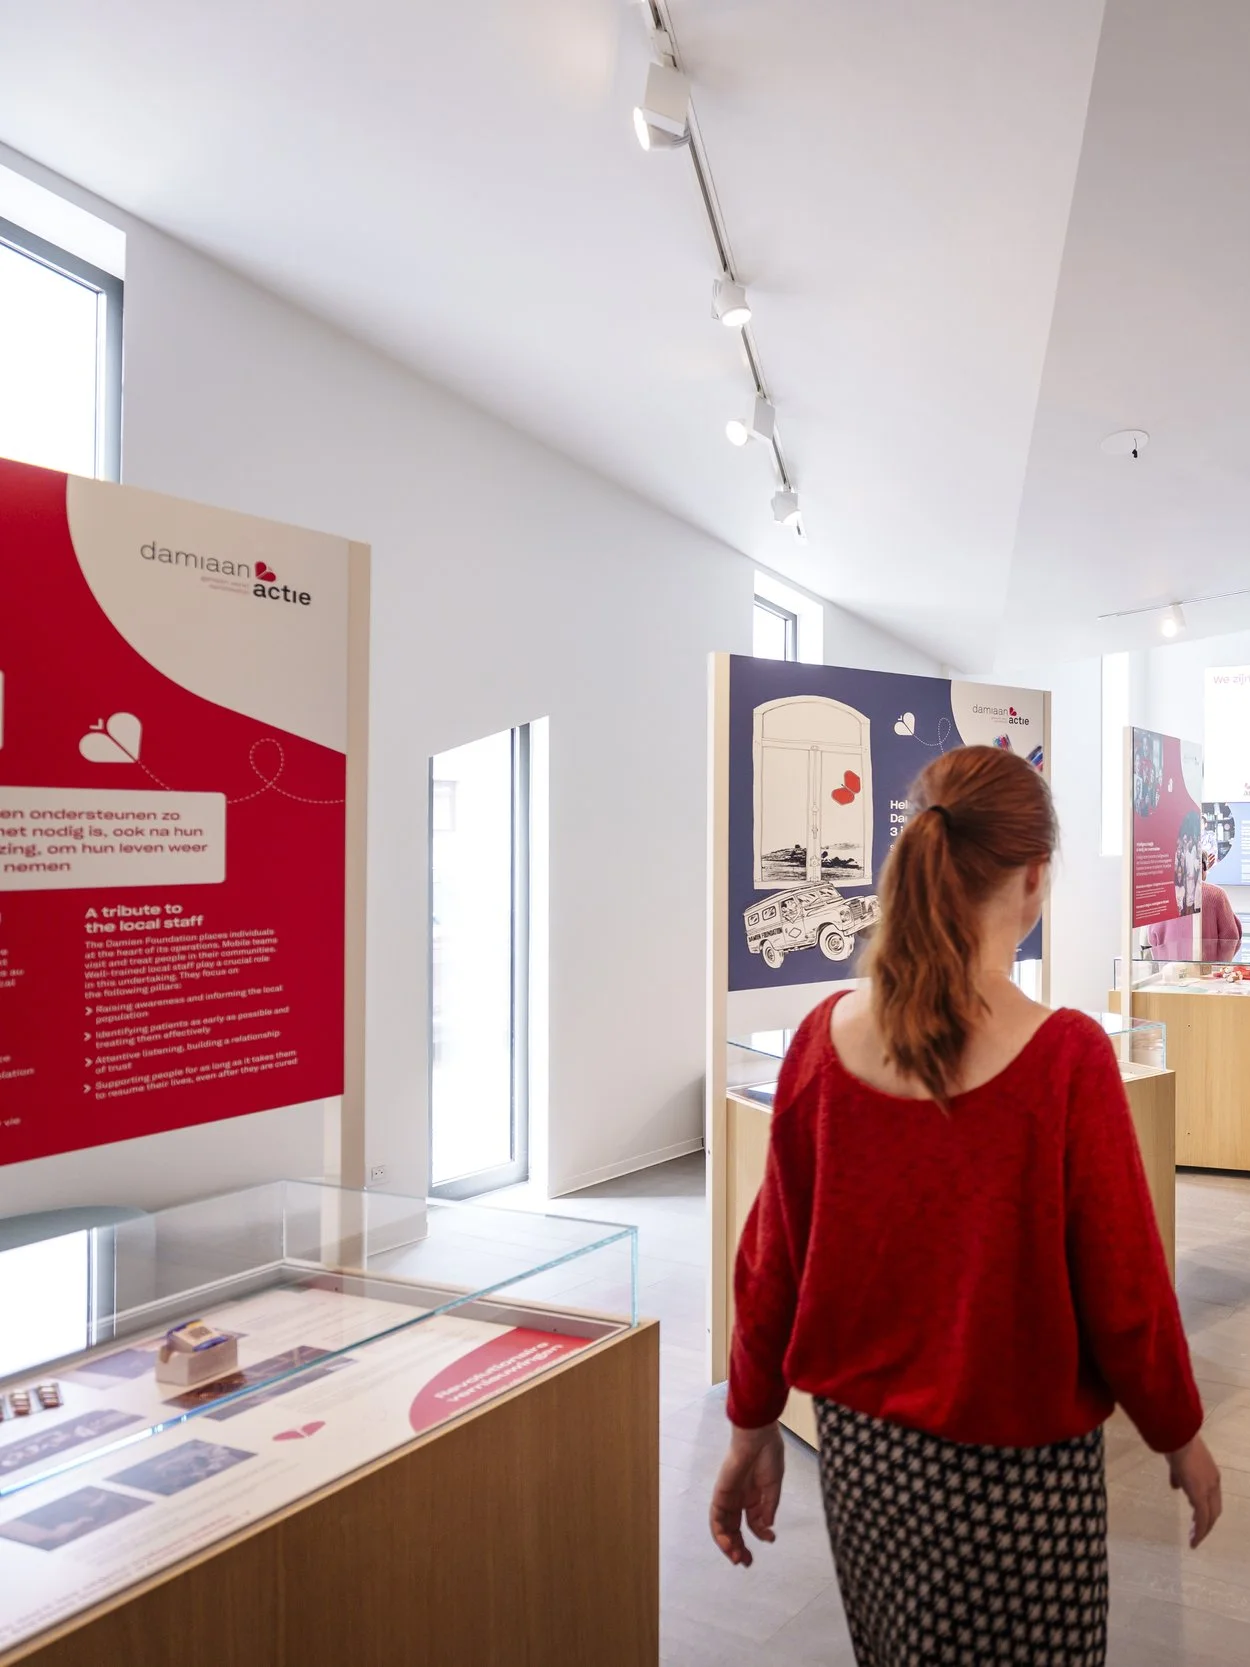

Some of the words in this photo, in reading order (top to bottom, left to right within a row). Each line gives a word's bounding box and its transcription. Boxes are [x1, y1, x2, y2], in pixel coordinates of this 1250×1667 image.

[140, 541, 250, 578] damiaan
[253, 583, 312, 605] actie
[1213, 675, 1230, 684] We
[972, 704, 1009, 716] damiaan
[1008, 716, 1030, 726] actie
[30, 809, 157, 821] ondersteunen
[162, 812, 181, 821] zo
[32, 825, 84, 840] nodig
[88, 825, 108, 838] is,
[112, 826, 145, 837] ook
[150, 828, 170, 837] na
[174, 826, 204, 837] hun
[47, 844, 76, 855] om
[81, 843, 115, 854] hun
[119, 843, 164, 853] leven
[168, 844, 209, 853] weer
[3, 862, 71, 873] nemen
[85, 907, 98, 919] A
[101, 904, 162, 918] tribute
[164, 903, 183, 914] to
[84, 922, 116, 934] the
[119, 918, 161, 932] local
[163, 915, 204, 929] staff
[85, 941, 104, 949] The
[105, 939, 143, 948] Damien
[145, 935, 198, 945] Foundation
[199, 933, 228, 942] places
[229, 928, 275, 938] individuals
[85, 951, 96, 959] at
[97, 950, 115, 958] the
[116, 948, 142, 957] heart
[144, 946, 156, 954] of
[156, 945, 169, 953] its
[170, 942, 220, 953] operations.
[222, 939, 251, 948] Mobile
[252, 937, 278, 945] teams
[84, 960, 106, 969] visit
[108, 958, 128, 967] and
[129, 956, 152, 965] treat
[154, 954, 186, 964] people
[187, 952, 196, 960] in
[198, 951, 219, 959] their
[147, 964, 171, 973] local
[172, 961, 195, 971] staff
[195, 961, 215, 970] play
[223, 956, 252, 966] crucial
[253, 955, 270, 963] role
[84, 981, 95, 989] in
[96, 979, 116, 988] this
[179, 971, 200, 979] They
[202, 968, 226, 977] focus
[84, 990, 102, 999] the
[103, 985, 149, 998] following
[95, 1003, 133, 1013] Raising
[134, 997, 185, 1009] awareness
[186, 994, 204, 1003] and
[205, 990, 247, 1000] informing
[263, 984, 284, 993] local
[95, 1010, 149, 1025] population
[95, 1026, 149, 1039] Identifying
[150, 1020, 189, 1032] patients
[202, 1015, 224, 1024] early
[237, 1008, 272, 1021] possible
[273, 1006, 290, 1014] and
[95, 1038, 136, 1049] treating
[136, 1034, 162, 1043] them
[163, 1026, 211, 1039] effectively
[95, 1051, 141, 1064] Attentive
[186, 1039, 224, 1051] building
[231, 1030, 281, 1043] relationship
[95, 1065, 106, 1075] of
[107, 1062, 133, 1072] trust
[95, 1074, 150, 1090] Supporting
[151, 1069, 184, 1080] people
[185, 1066, 198, 1075] for
[211, 1061, 231, 1070] long
[251, 1054, 275, 1063] takes
[275, 1050, 297, 1059] them
[95, 1092, 106, 1100] to
[107, 1086, 145, 1097] resume
[146, 1081, 169, 1090] their
[195, 1073, 217, 1082] even
[218, 1069, 239, 1078] after
[240, 1064, 259, 1074] they
[274, 1058, 298, 1067] cured
